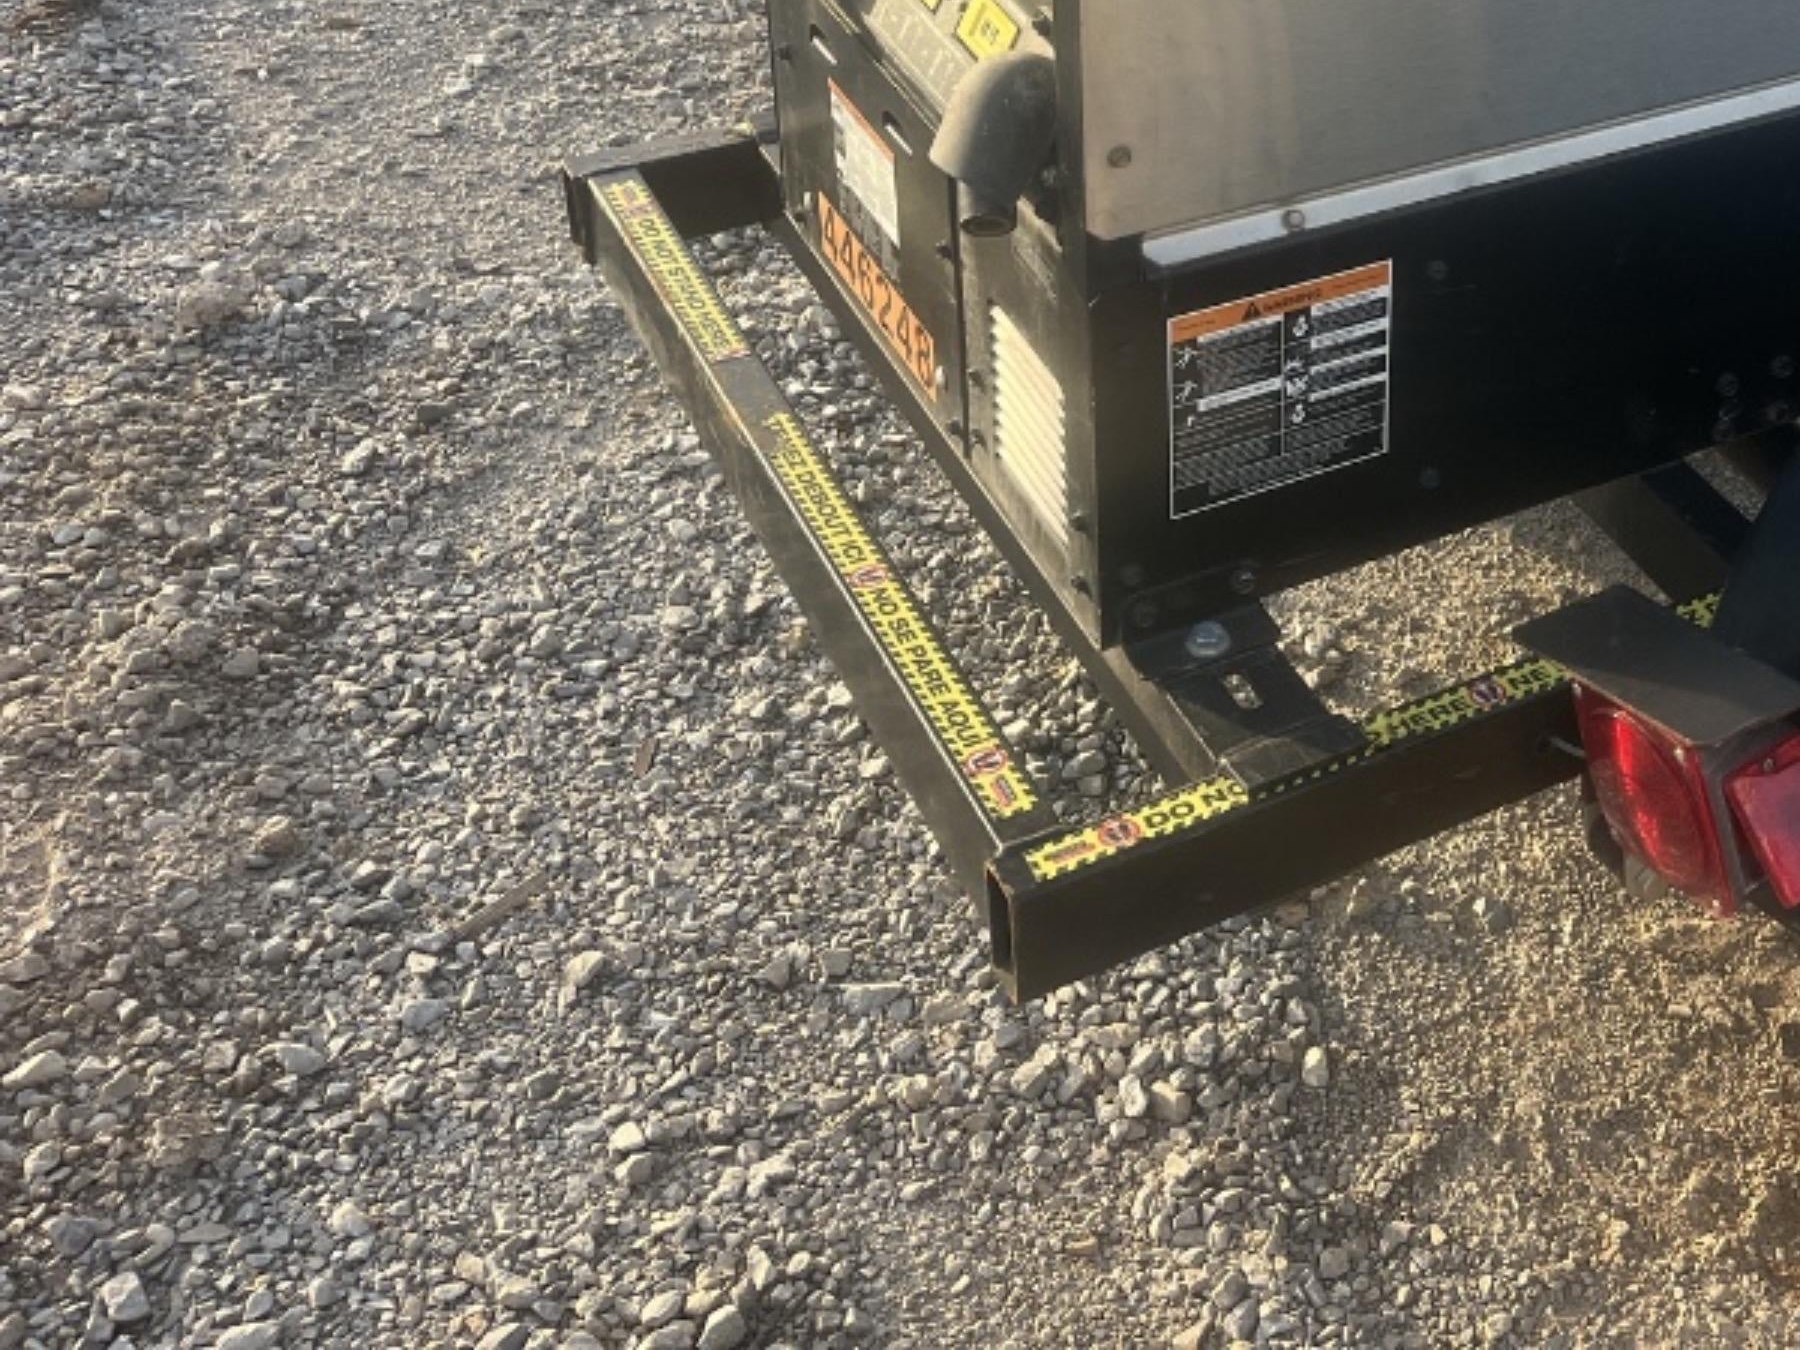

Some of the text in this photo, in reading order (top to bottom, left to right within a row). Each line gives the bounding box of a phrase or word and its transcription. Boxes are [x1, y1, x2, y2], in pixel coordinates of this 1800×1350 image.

[823, 201, 935, 390] 446248
[796, 470, 848, 542] DEBOUT
[839, 531, 867, 564] ICI
[870, 587, 898, 616] NO
[888, 615, 919, 647] SE
[908, 643, 952, 701] PARE
[1144, 801, 1195, 828] DO
